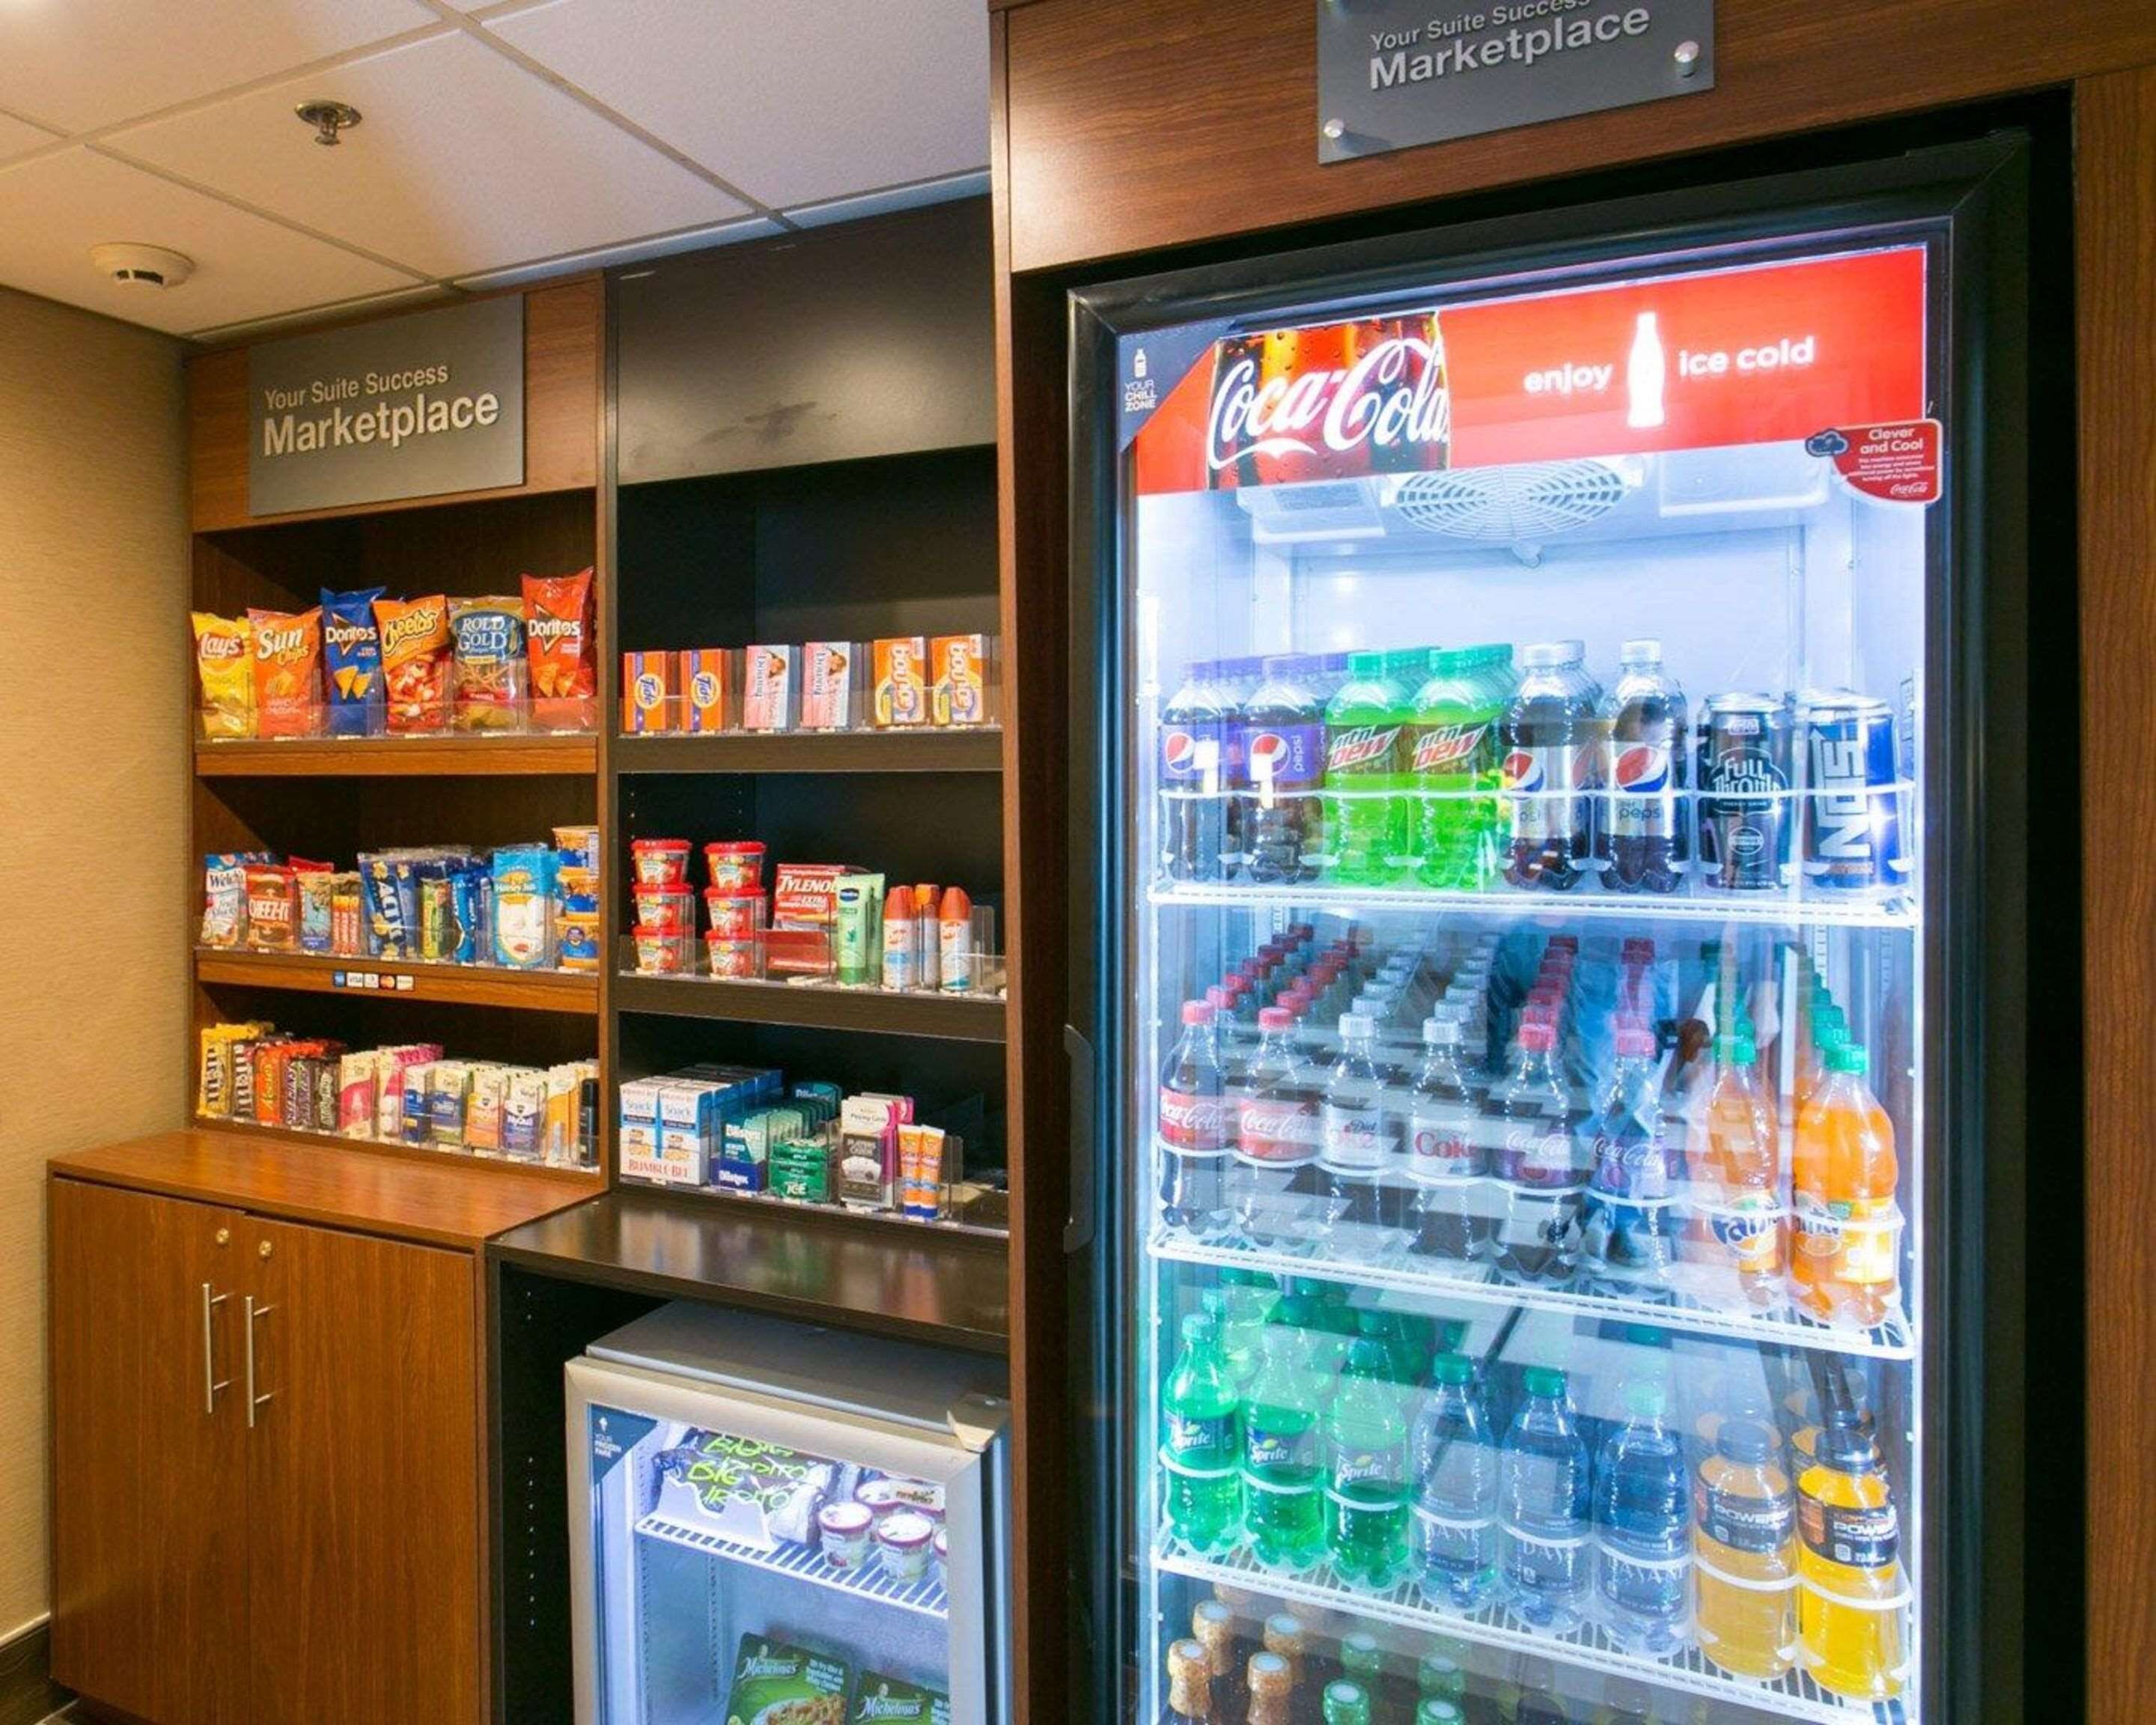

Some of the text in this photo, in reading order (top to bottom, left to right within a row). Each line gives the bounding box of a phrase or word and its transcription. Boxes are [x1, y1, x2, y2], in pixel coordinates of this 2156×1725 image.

[1371, 28, 1420, 52] Your
[1428, 12, 1484, 40] Suite
[1369, 7, 1650, 91] Marketplace
[1523, 335, 1815, 395] enjoy ice cold
[264, 365, 448, 411] Your Suite Success
[1124, 379, 1154, 393] YOUR
[1124, 390, 1157, 403] CHILL
[1208, 338, 1449, 469] Coca-Cola
[1124, 400, 1156, 413] ZONE
[264, 392, 499, 457] Marketplace
[1869, 428, 1916, 440] Clever
[1860, 438, 1924, 454] and Cool
[462, 616, 505, 632] ROLD
[528, 619, 580, 636] Doritos
[258, 627, 303, 660] Sun
[326, 627, 377, 644] Doritos
[458, 631, 507, 651] GOLD
[1618, 806, 1660, 821] peps
[1172, 1430, 1211, 1449] Sprite
[1251, 1443, 1288, 1462] Sprite
[1341, 1461, 1383, 1482] Sprite
